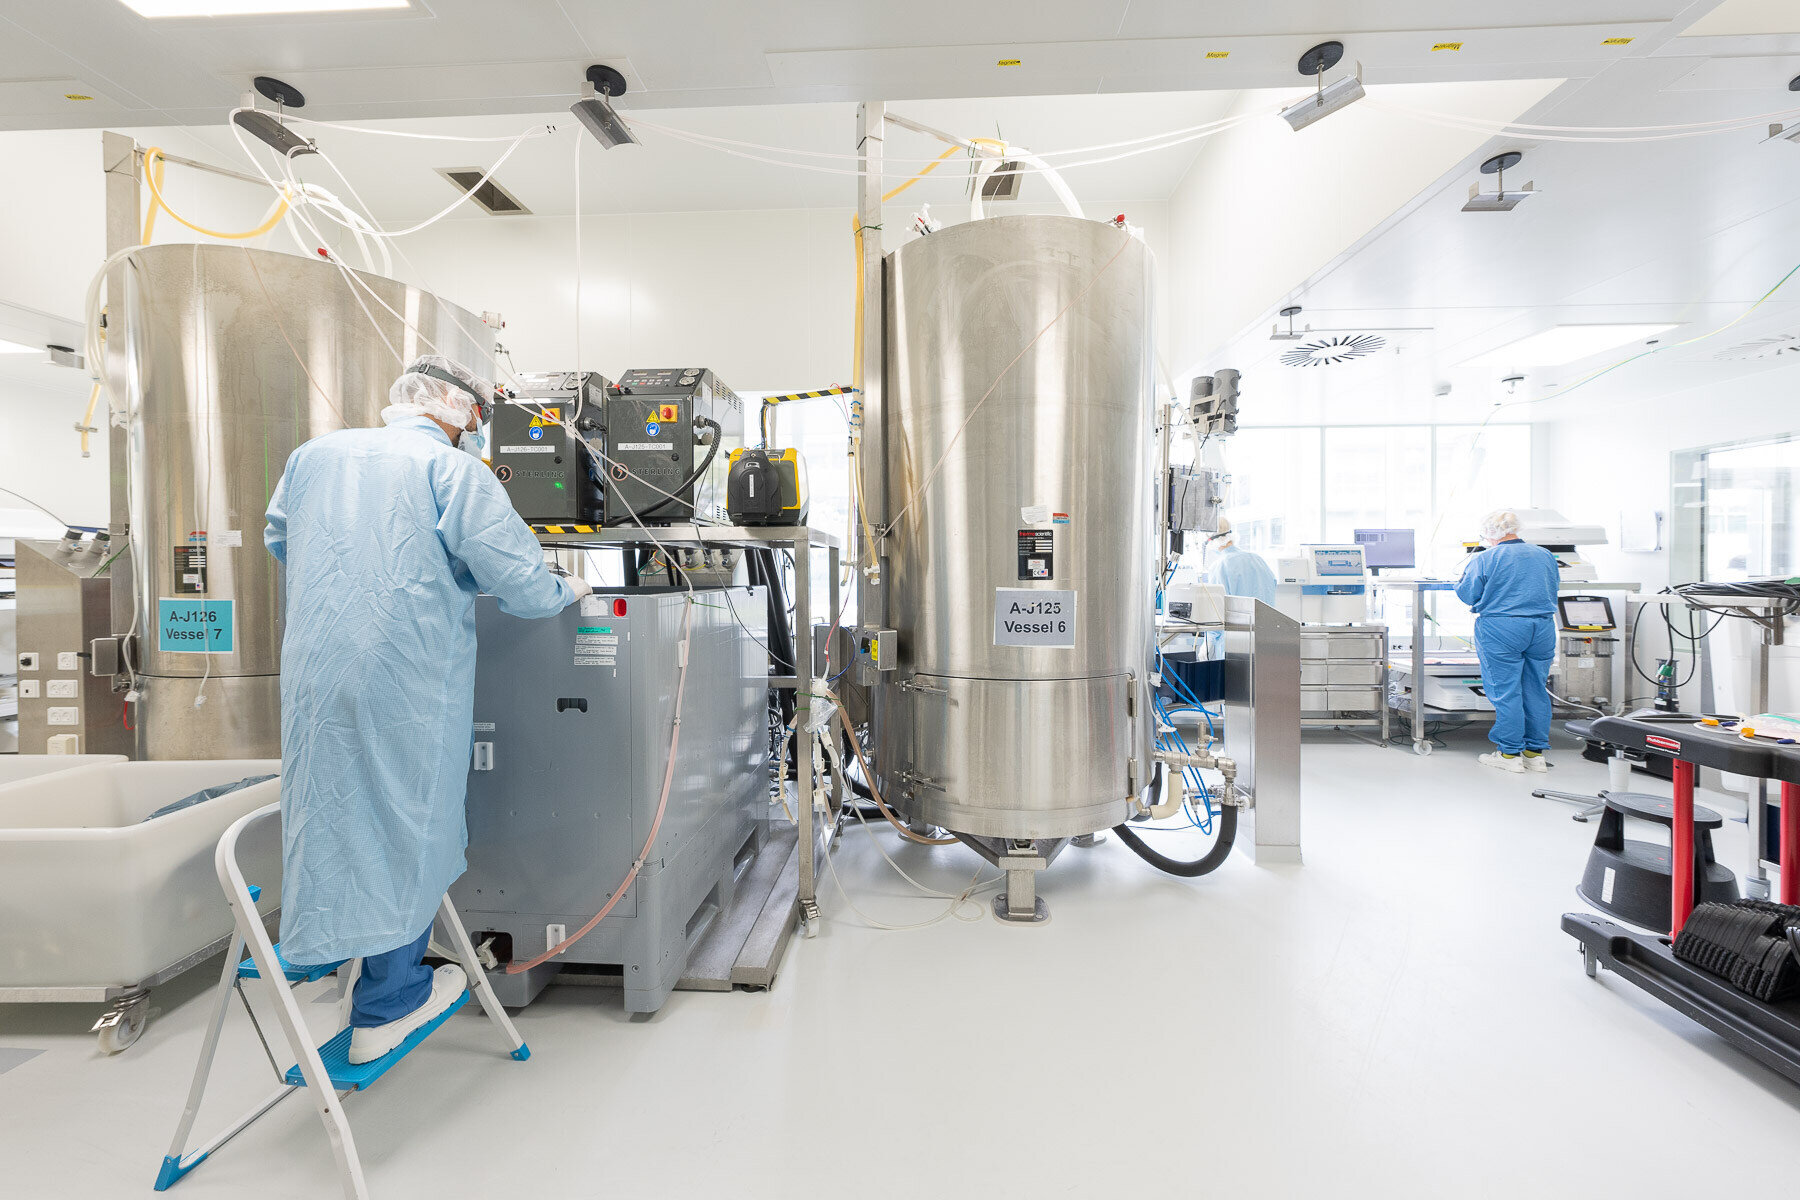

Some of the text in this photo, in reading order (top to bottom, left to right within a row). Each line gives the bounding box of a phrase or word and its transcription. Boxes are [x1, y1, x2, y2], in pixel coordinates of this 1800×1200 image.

[1009, 601, 1061, 614] A-J125
[169, 611, 217, 622] A-J126
[1004, 621, 1066, 633] Vessel 6
[214, 628, 222, 640] 7
